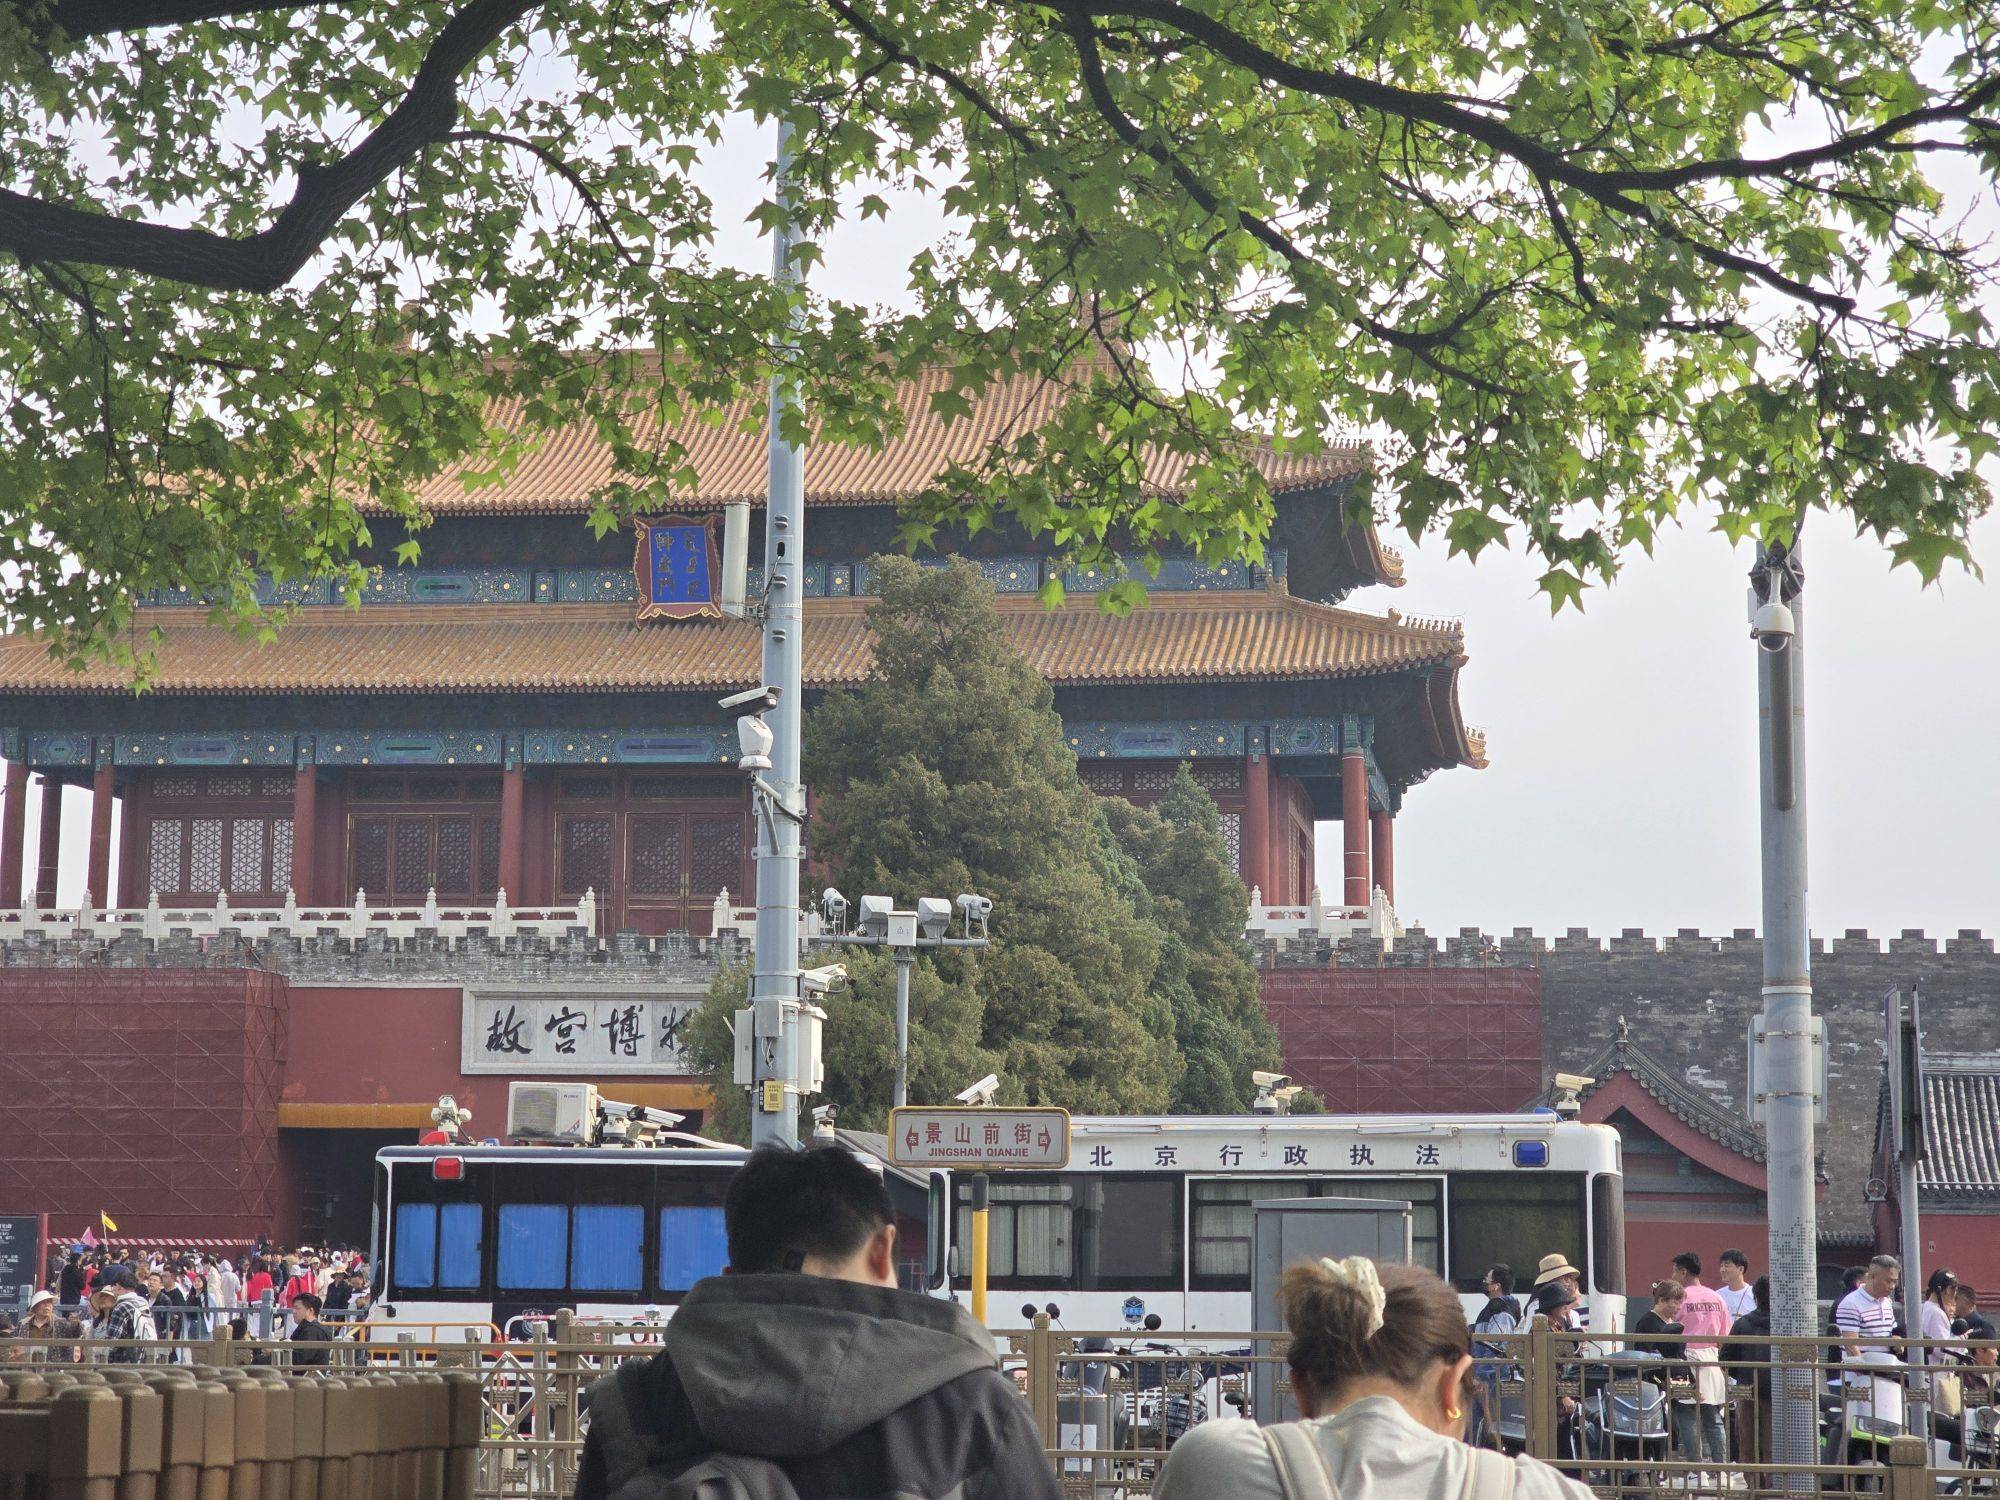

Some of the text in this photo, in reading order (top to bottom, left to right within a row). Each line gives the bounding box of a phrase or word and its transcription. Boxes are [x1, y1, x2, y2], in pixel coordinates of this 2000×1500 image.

[925, 1122, 1032, 1145] 景山前街
[928, 1147, 1029, 1157] JINGSHAN QIANJIE
[1090, 1144, 1440, 1167] 北京行政执法
